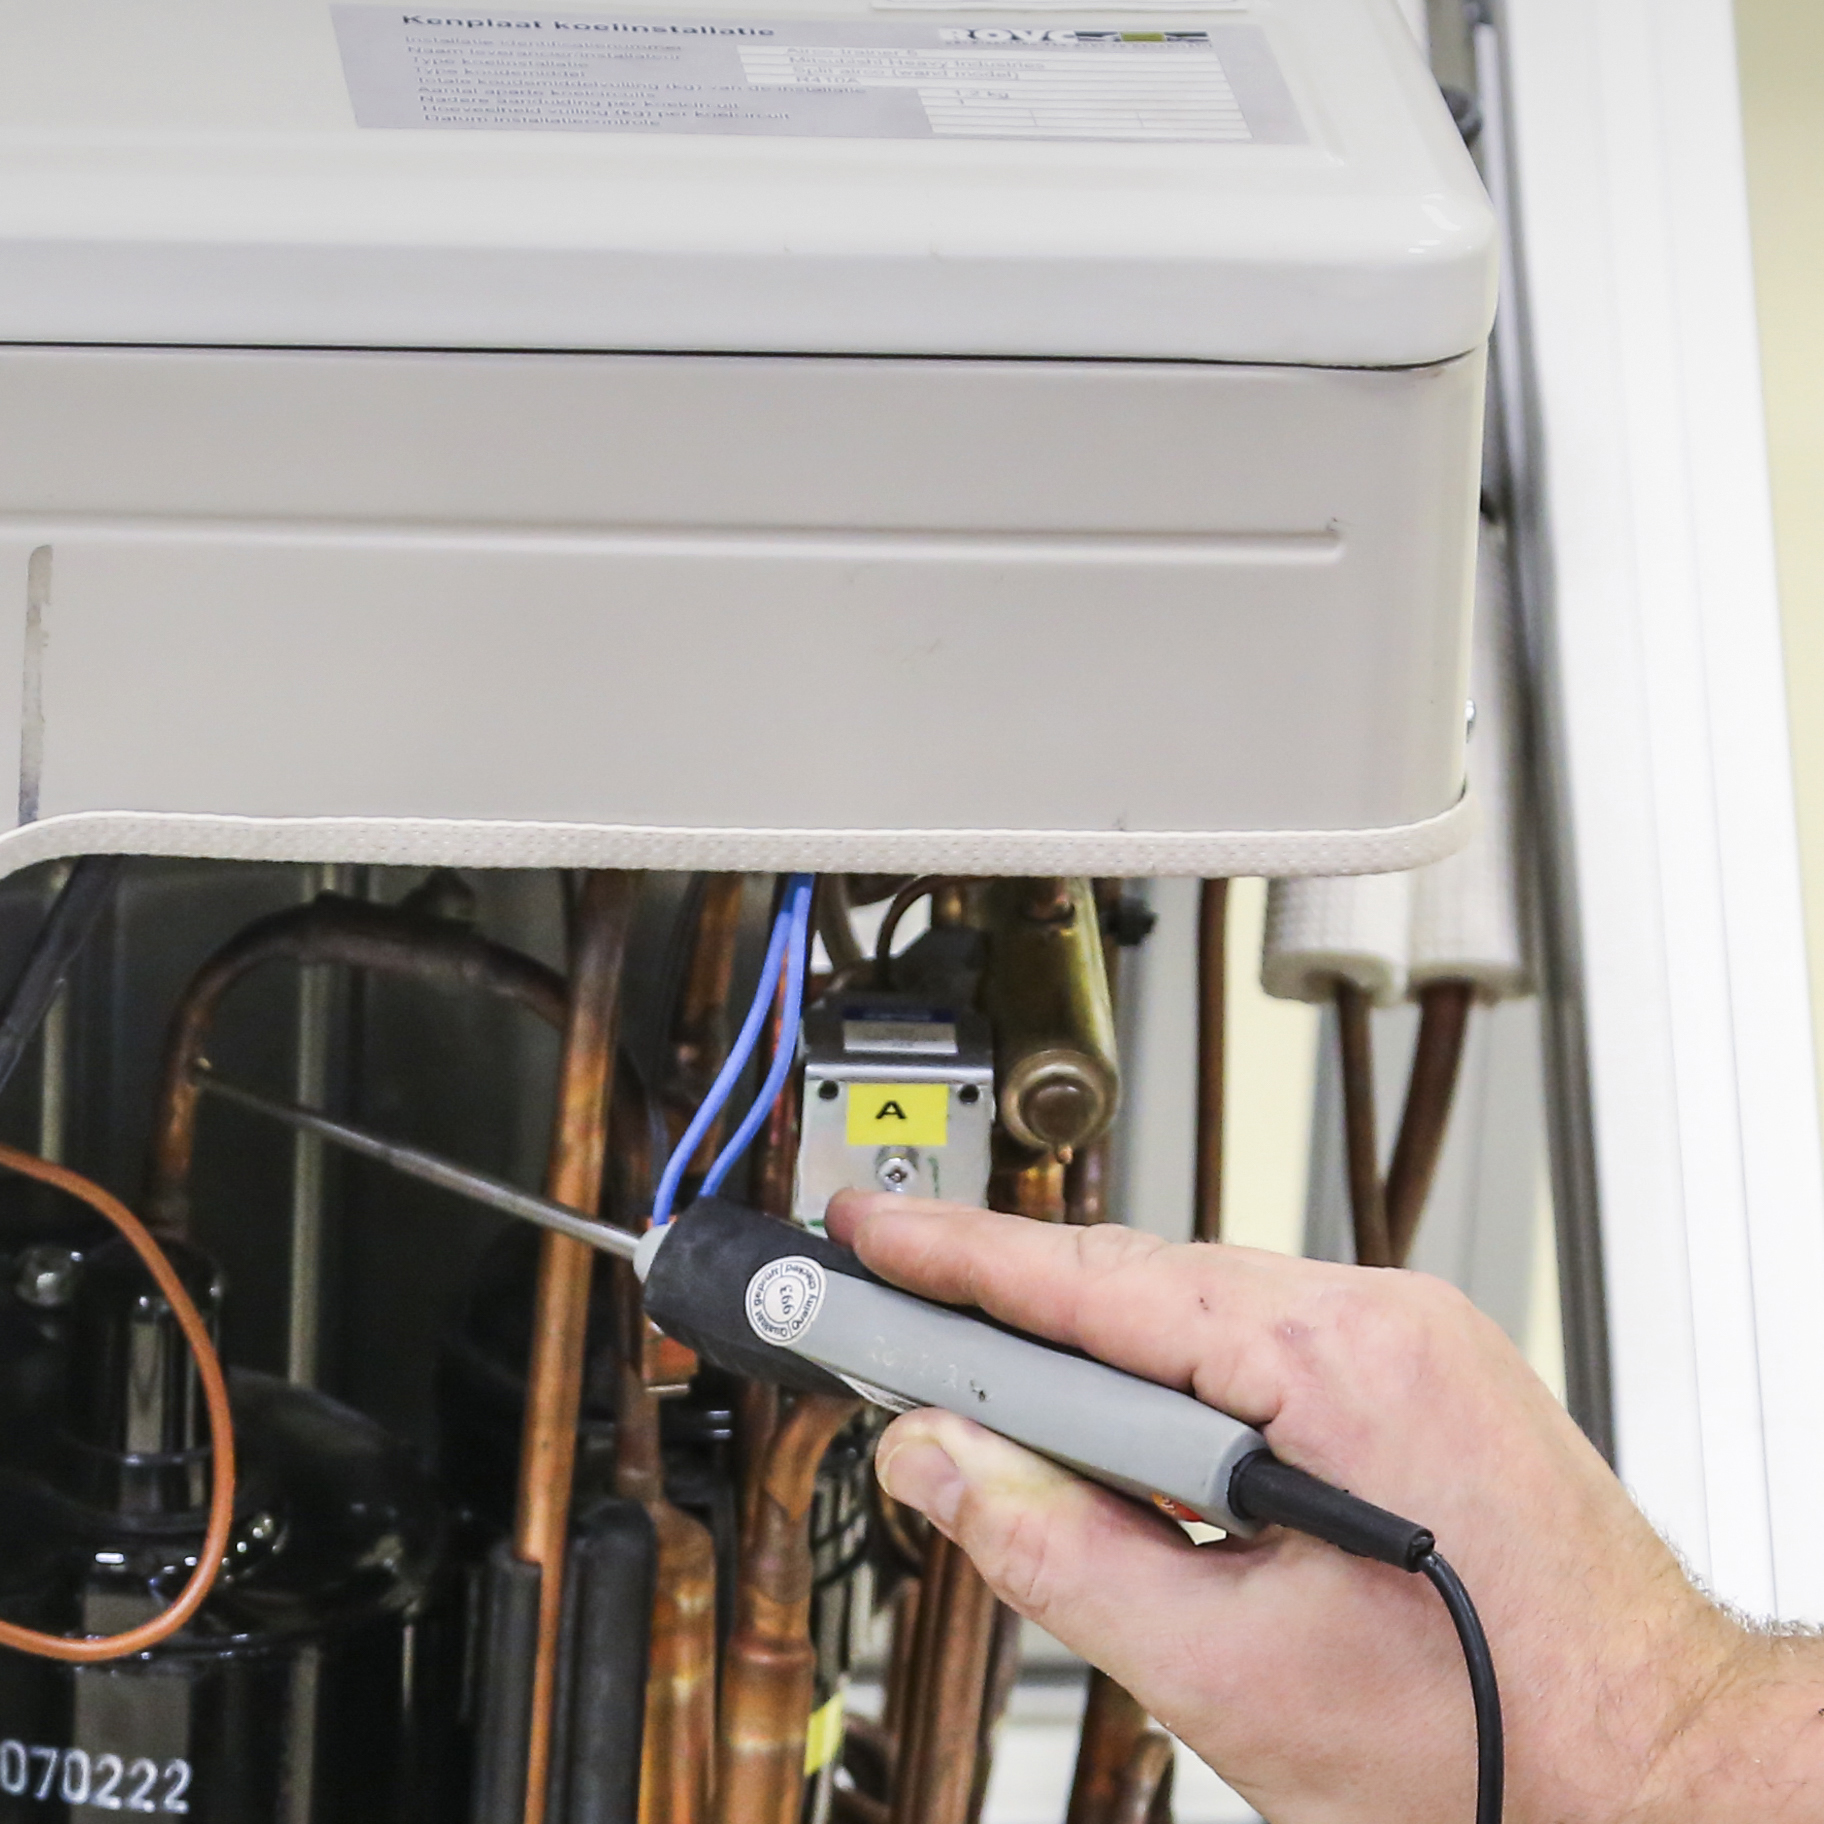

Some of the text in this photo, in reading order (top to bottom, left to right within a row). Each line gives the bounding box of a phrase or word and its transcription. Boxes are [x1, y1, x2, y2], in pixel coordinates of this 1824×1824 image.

[402, 14, 775, 36] Kenplaat koelinstallatie
[939, 28, 1077, 42] ROVC
[876, 1101, 907, 1120] A
[779, 1284, 796, 1315] 993
